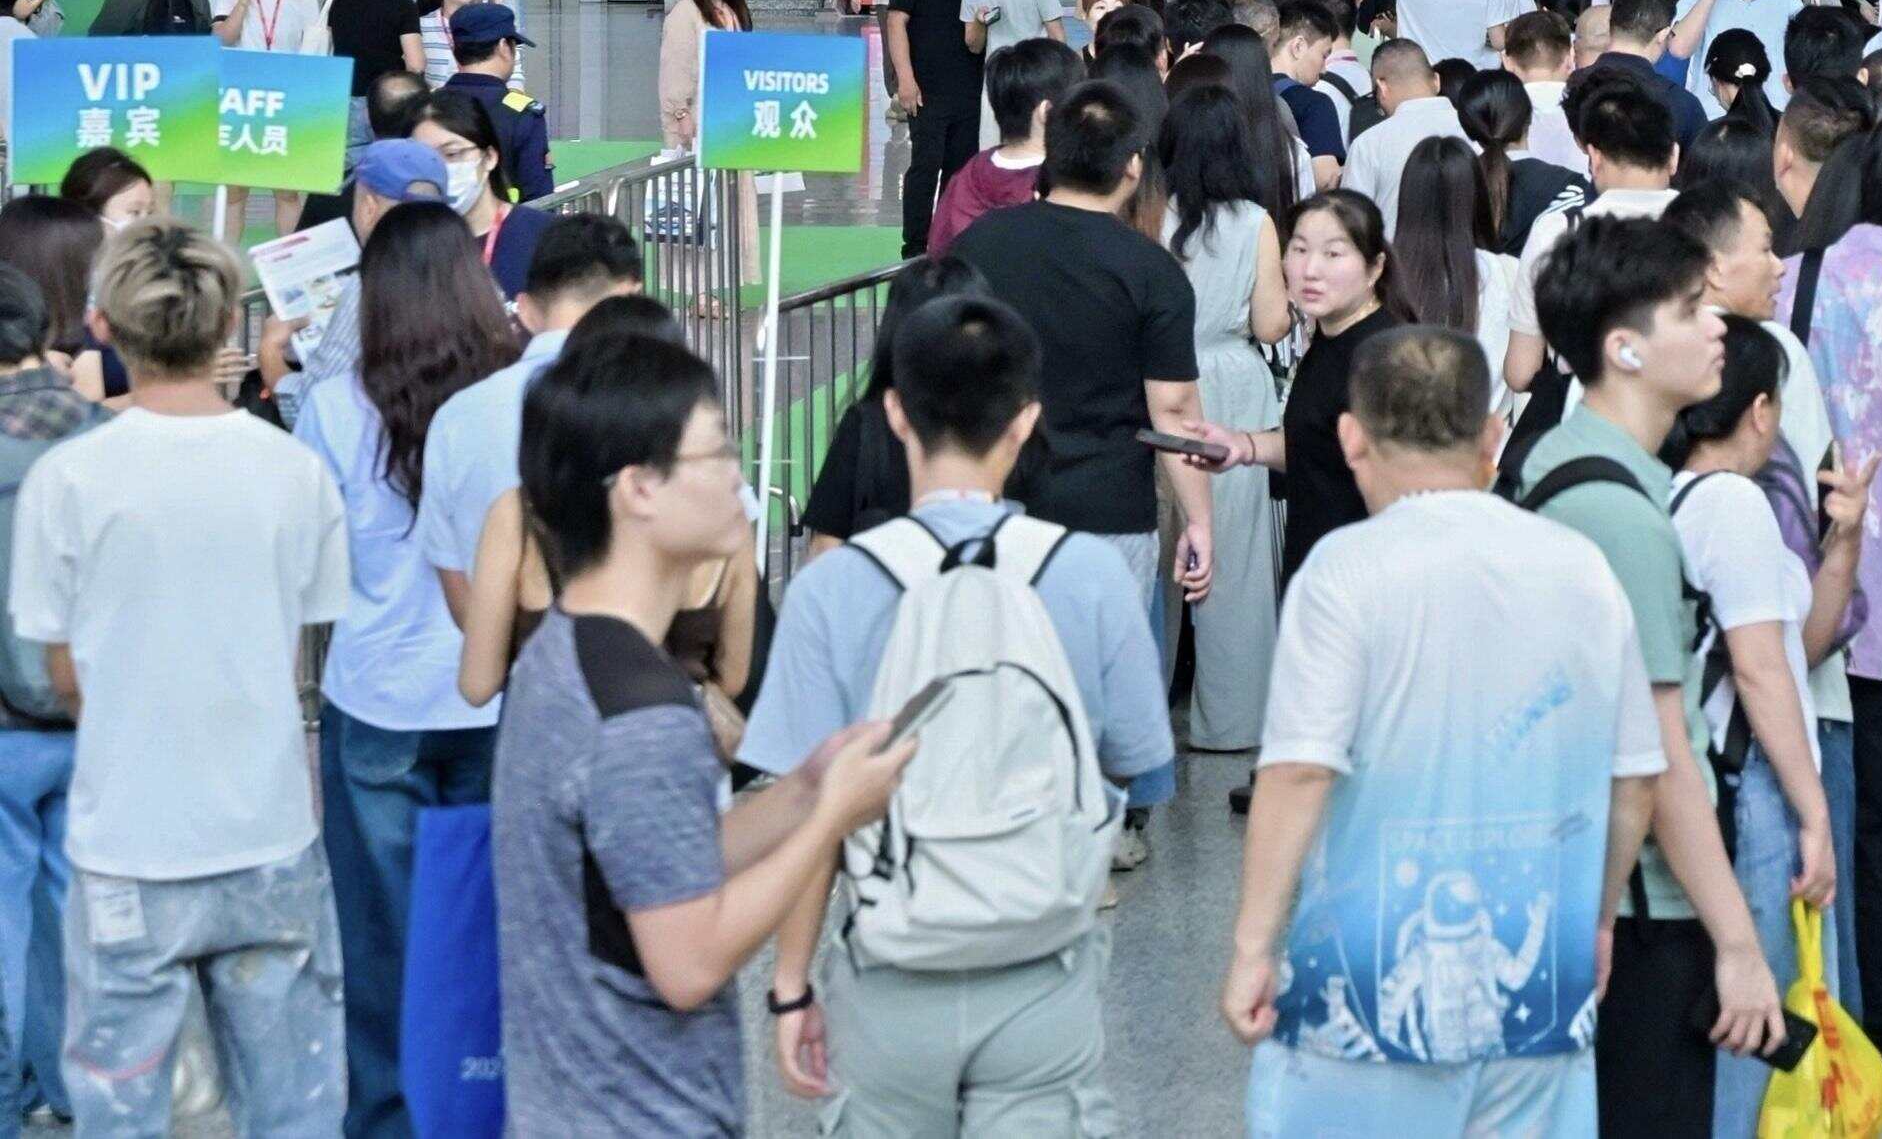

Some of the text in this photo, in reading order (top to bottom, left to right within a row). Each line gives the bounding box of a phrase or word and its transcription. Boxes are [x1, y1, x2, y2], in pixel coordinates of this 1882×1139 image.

[77, 63, 161, 101] VIP
[743, 69, 830, 94] VISITORS
[219, 87, 286, 117] AFF
[752, 100, 818, 138] 观众
[76, 107, 161, 148] 嘉宾
